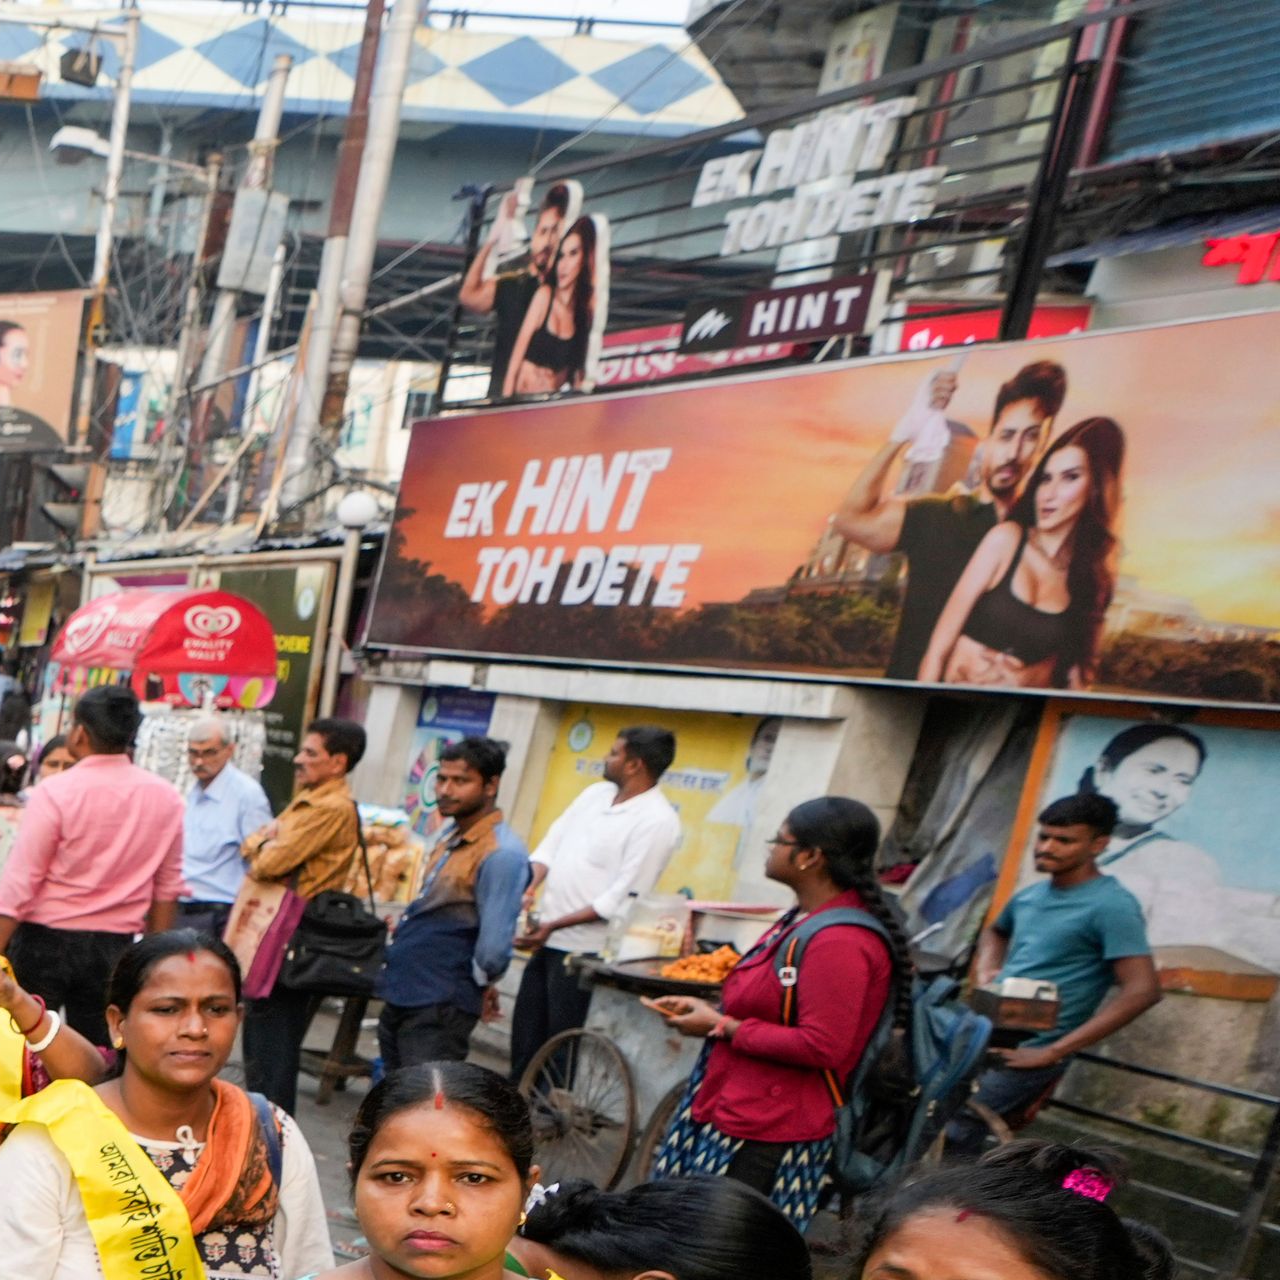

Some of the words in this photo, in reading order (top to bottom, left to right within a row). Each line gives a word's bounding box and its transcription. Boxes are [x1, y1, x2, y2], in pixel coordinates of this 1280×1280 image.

[694, 151, 753, 209] EK
[756, 97, 917, 191] HINT
[748, 285, 863, 338] HINT
[445, 481, 505, 538] EK
[509, 448, 671, 536] HINT
[471, 547, 562, 605] TOH
[562, 544, 700, 608] DETE
[100, 1142, 138, 1185] আমরা
